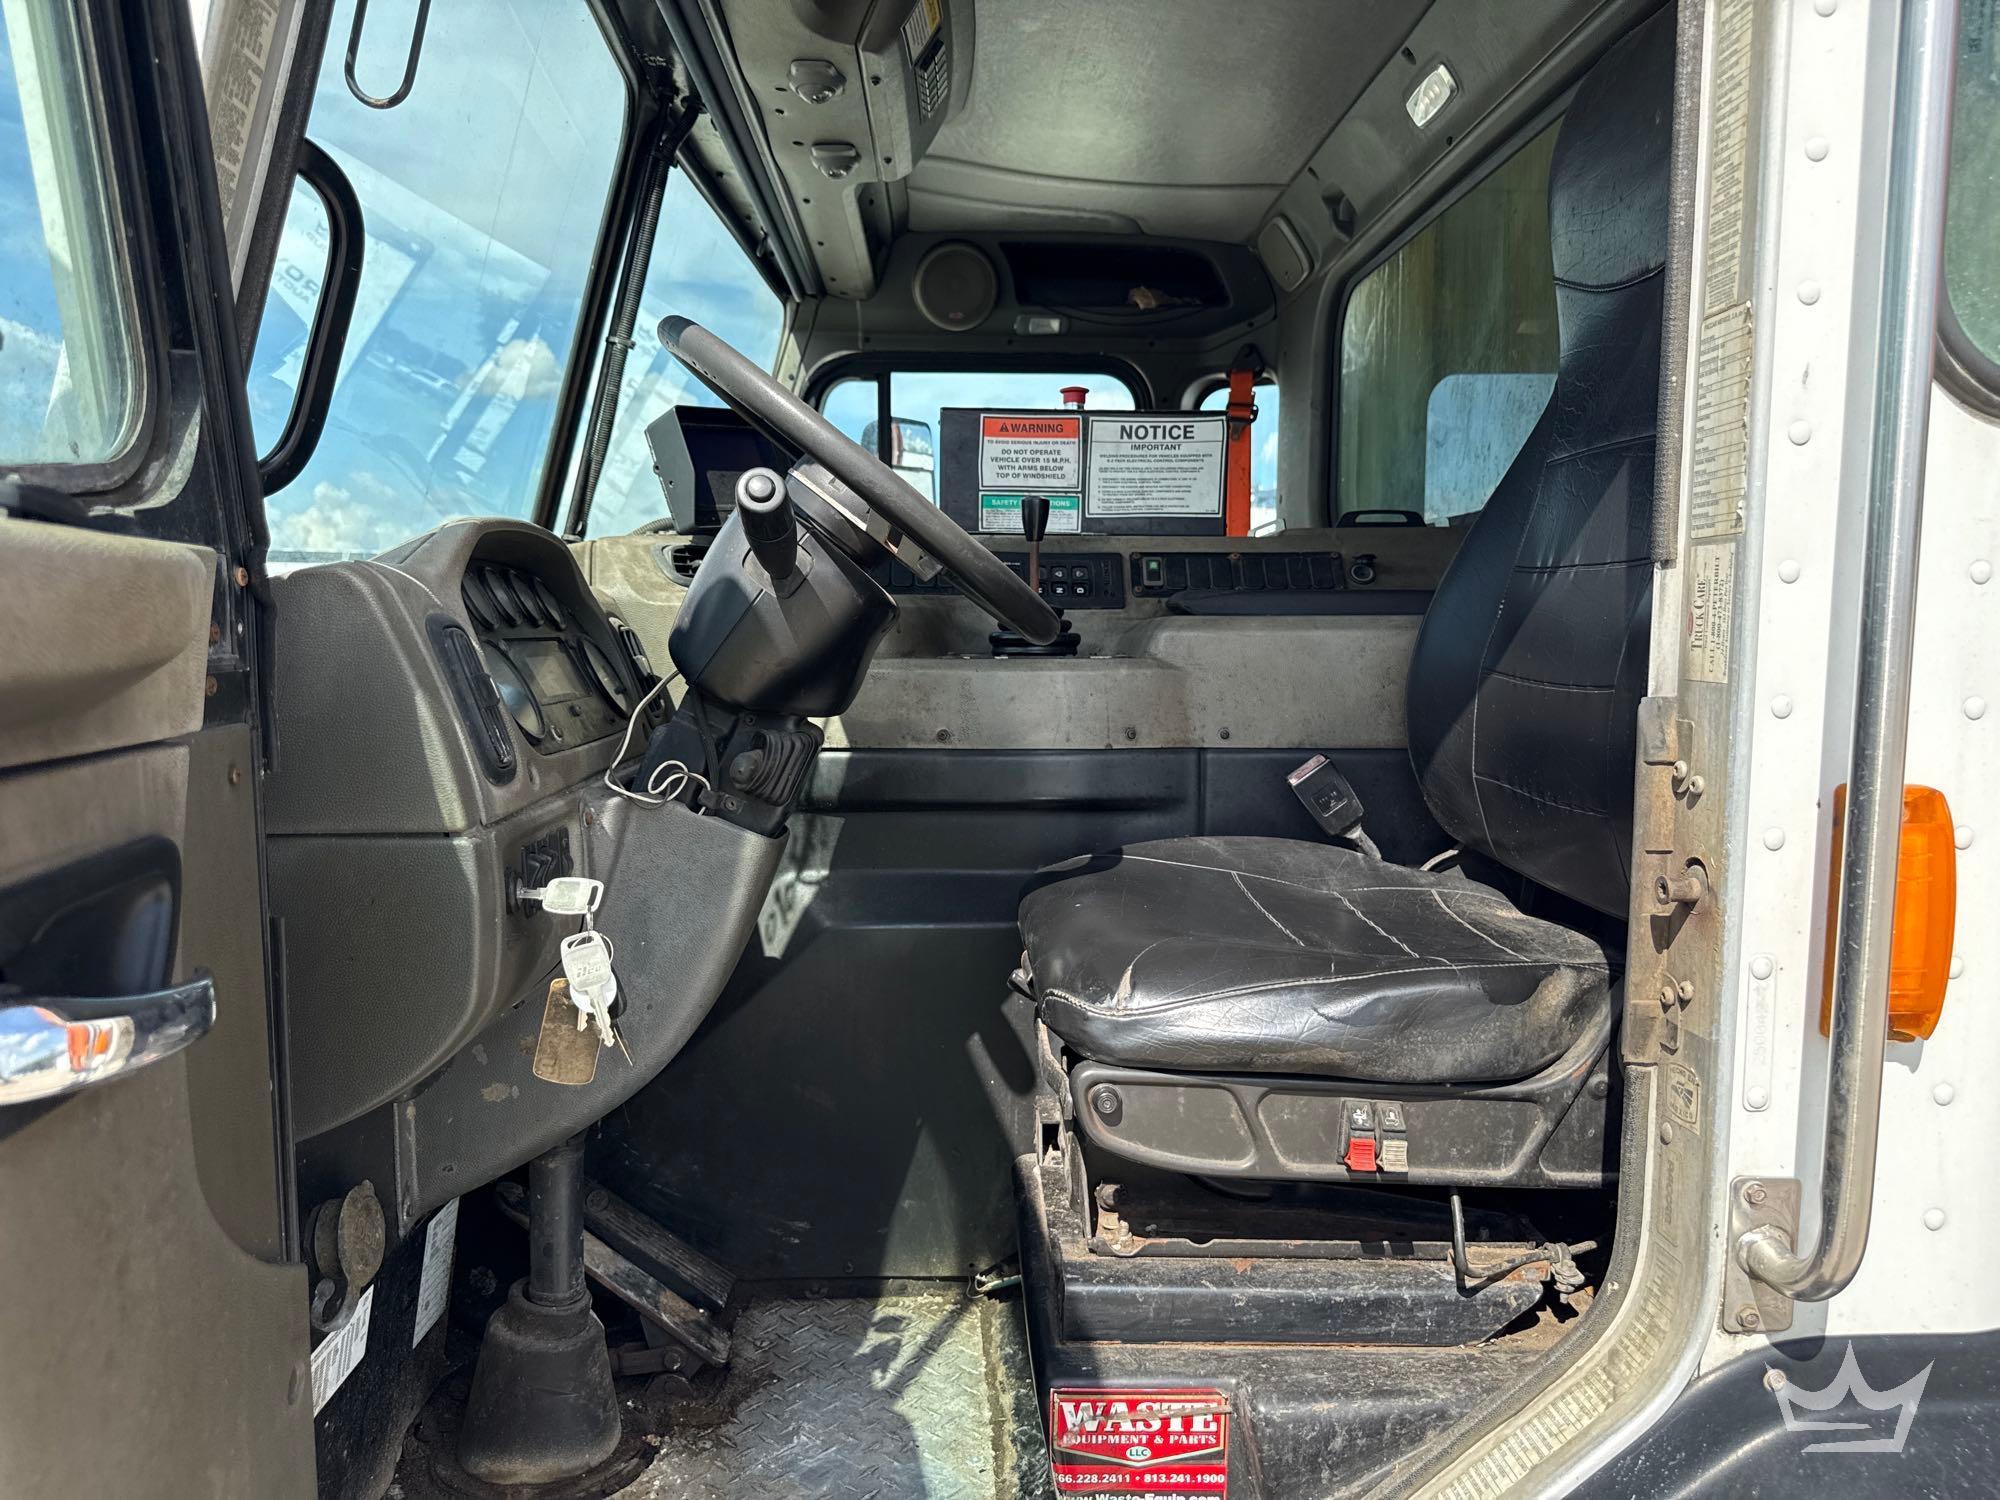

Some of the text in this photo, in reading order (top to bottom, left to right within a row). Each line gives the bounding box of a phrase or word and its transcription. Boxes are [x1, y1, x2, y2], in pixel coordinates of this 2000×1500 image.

[1011, 423, 1064, 433] WARNING
[1120, 425, 1195, 440] NOTICE
[1060, 1401, 1219, 1433] WASTE
[1063, 1434, 1217, 1445] EQUIPMENT & PARTS
[1129, 1449, 1148, 1457] LLC
[1056, 1473, 1225, 1484] 66.228.2411 813.241.1900
